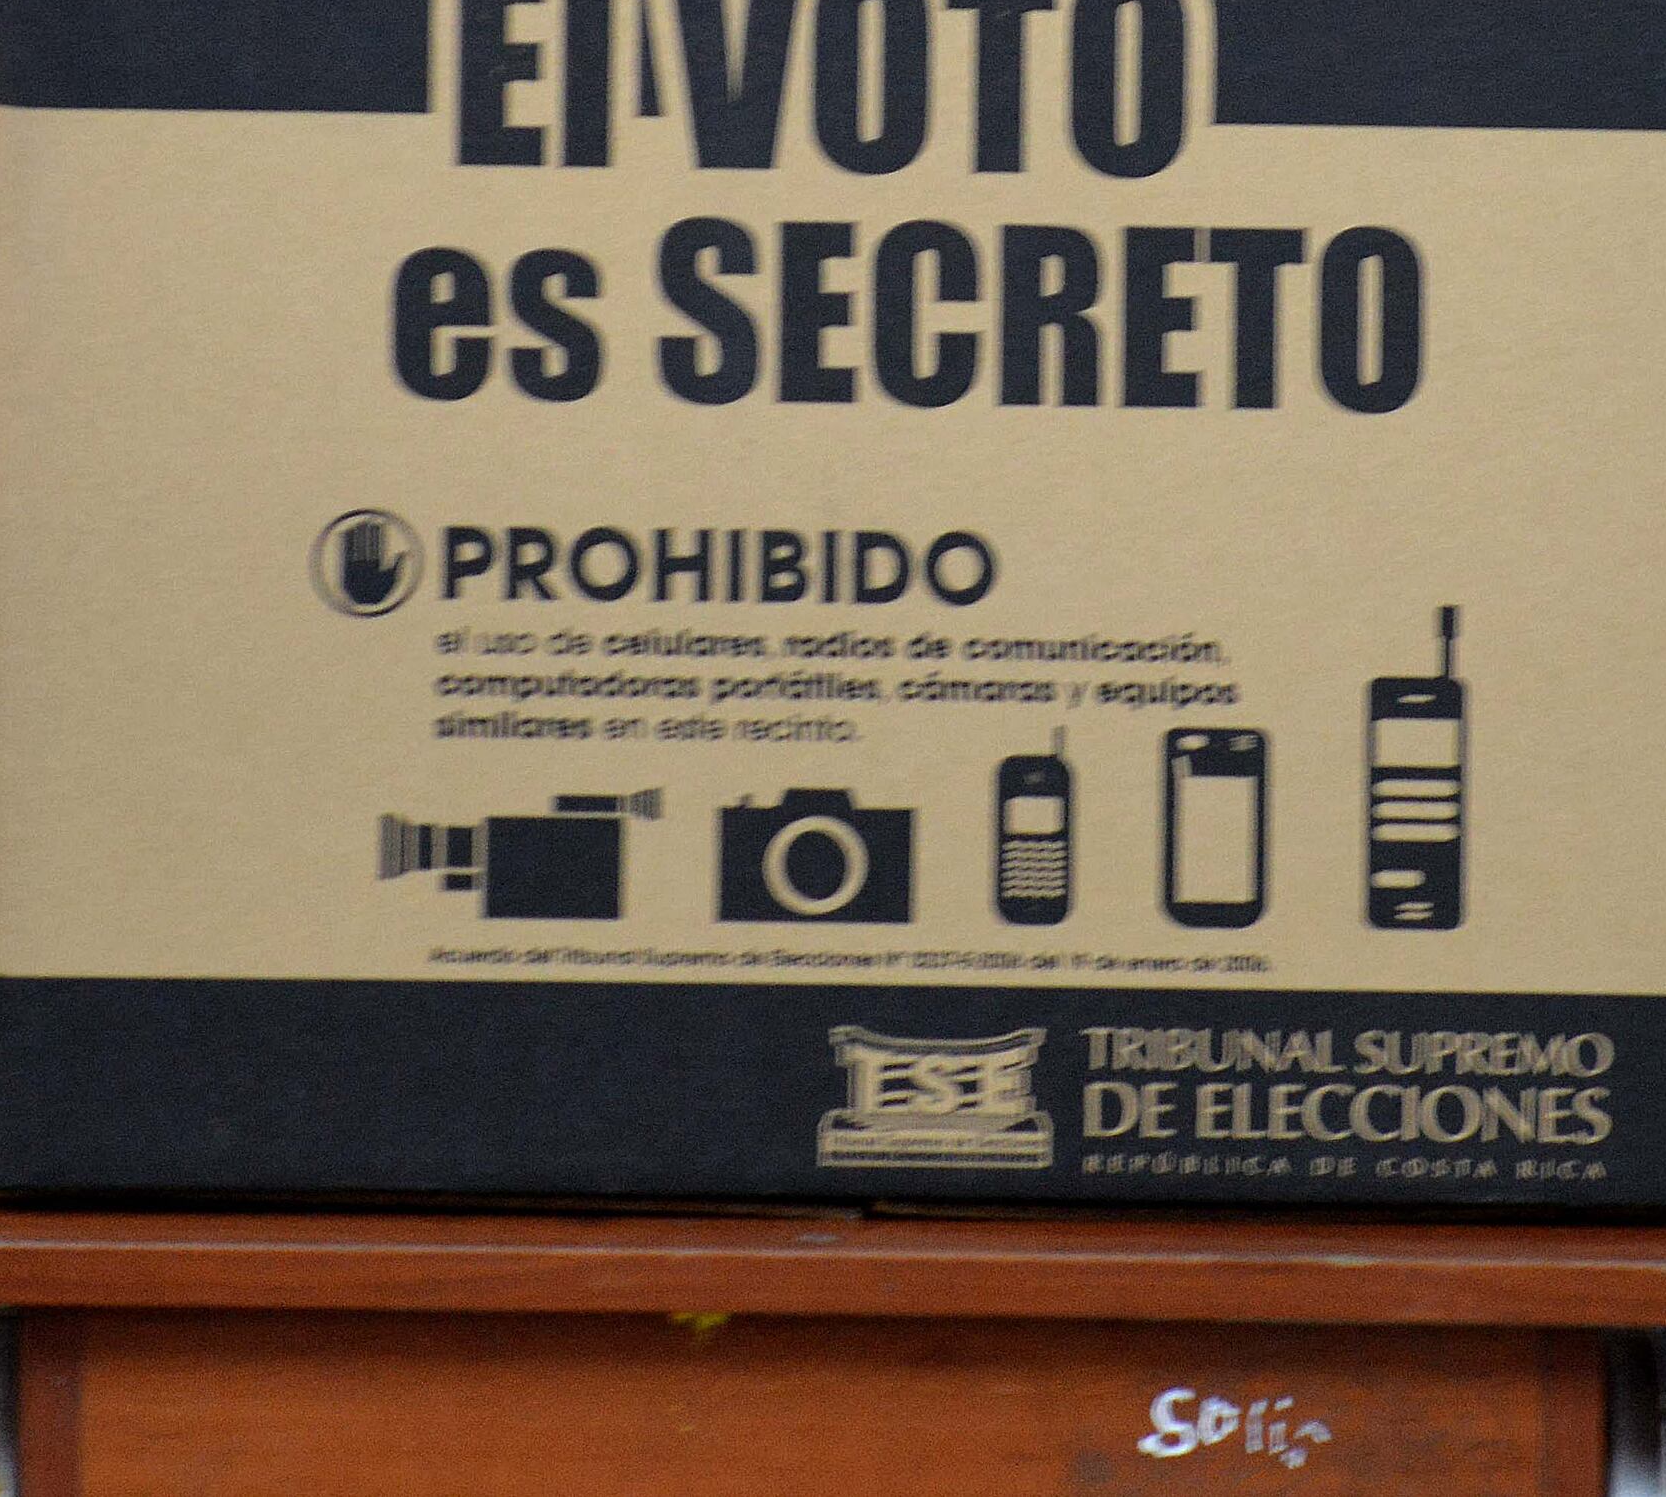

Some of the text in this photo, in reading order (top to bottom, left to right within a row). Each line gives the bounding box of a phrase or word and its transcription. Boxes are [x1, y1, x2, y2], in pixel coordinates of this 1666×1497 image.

[391, 216, 1425, 414] es SECRETO
[443, 526, 996, 606] PROHIBIDO
[437, 627, 467, 655] el
[548, 628, 593, 656] de
[785, 630, 895, 658] radios
[907, 632, 952, 659] de
[964, 632, 1232, 665] comunicación,
[437, 670, 701, 702] computadoras
[896, 670, 1055, 703] cámaras
[1063, 682, 1090, 709] y
[1098, 677, 1240, 709] equipos
[437, 709, 593, 740] similares
[604, 717, 646, 740] en
[658, 713, 725, 741] este
[1081, 1027, 1615, 1077] TRIBUNAL SUPREMO
[1084, 1082, 1614, 1143] DE ELECCIONES
